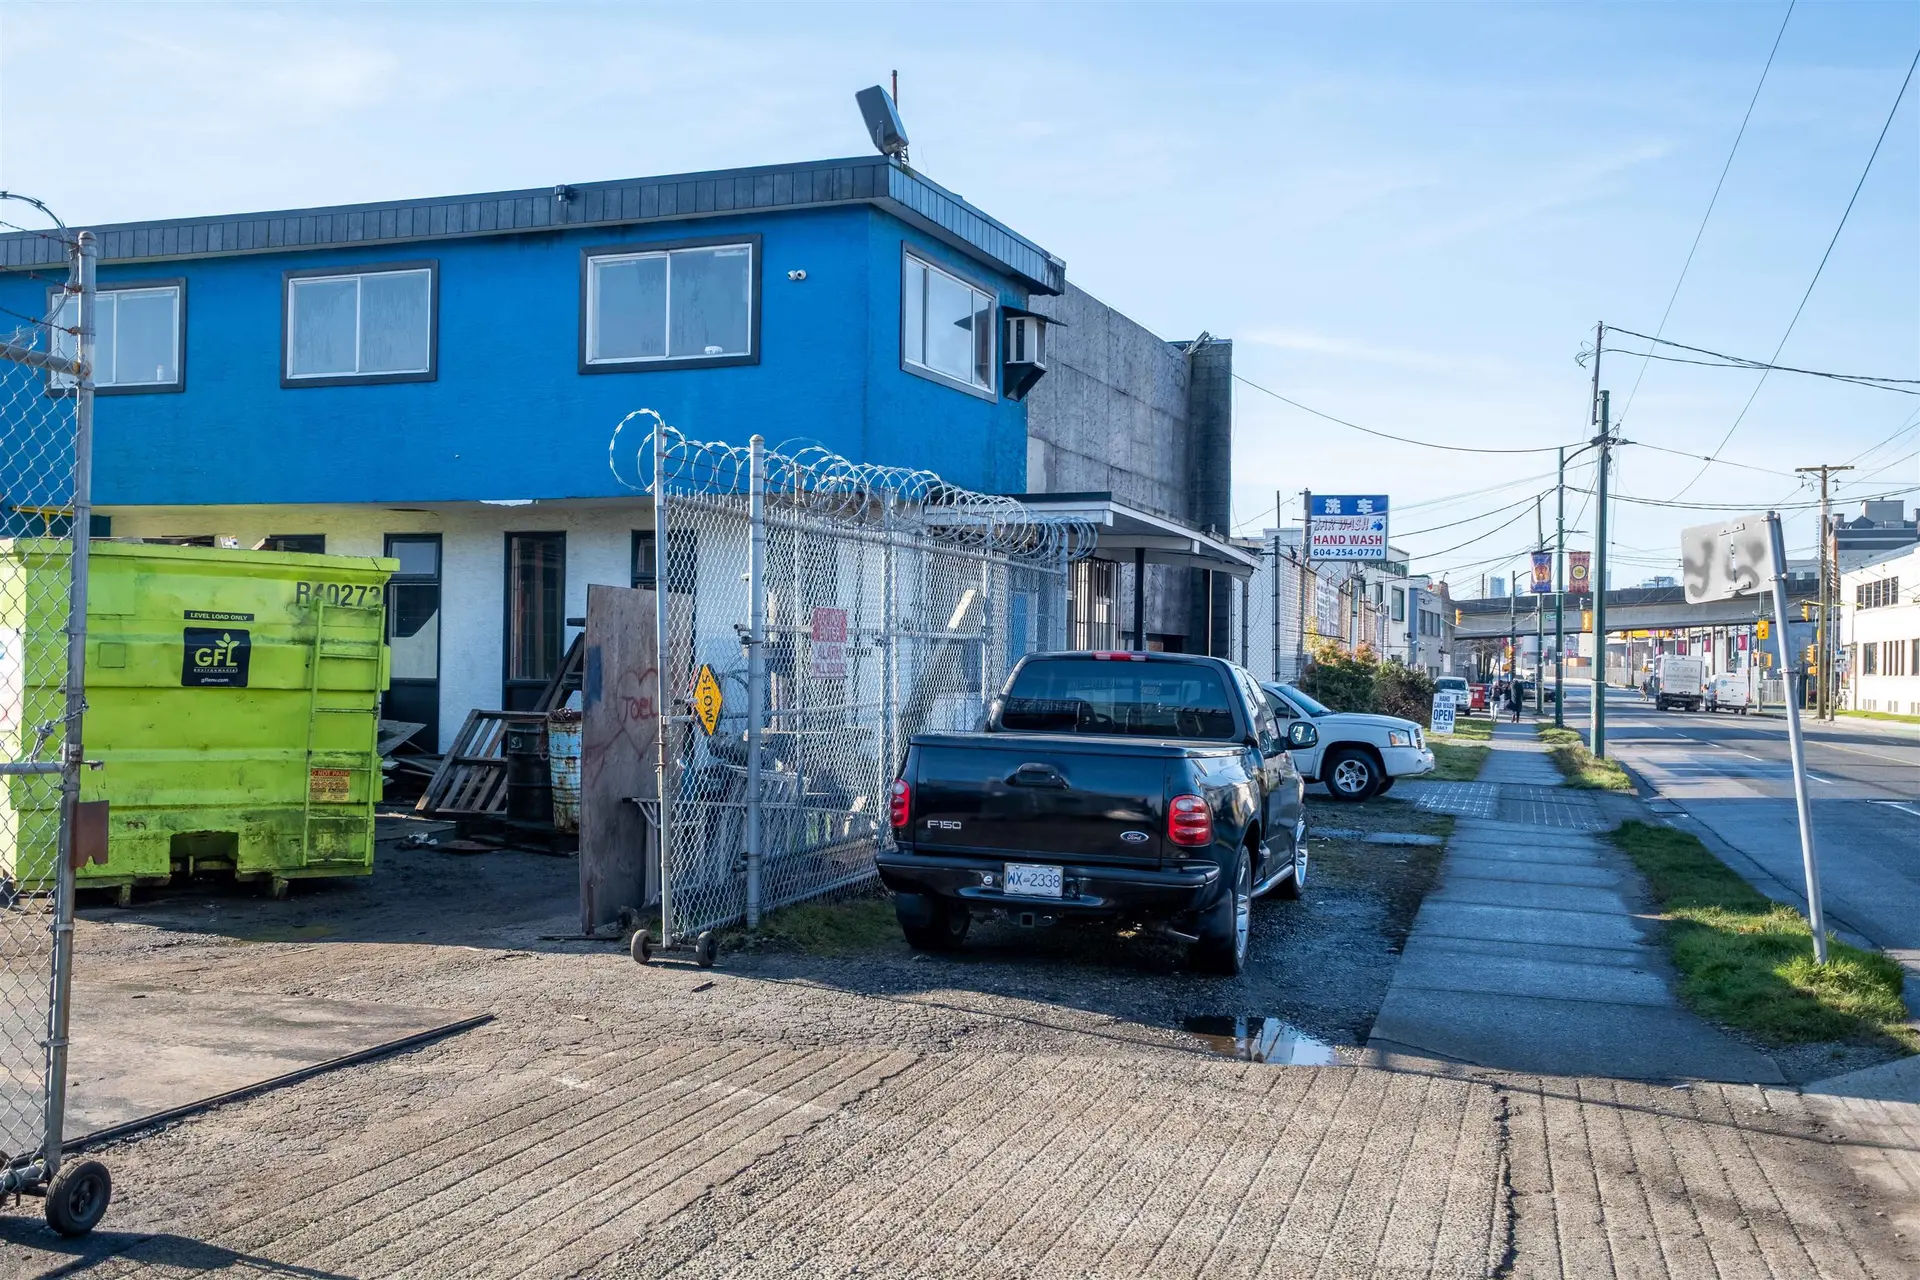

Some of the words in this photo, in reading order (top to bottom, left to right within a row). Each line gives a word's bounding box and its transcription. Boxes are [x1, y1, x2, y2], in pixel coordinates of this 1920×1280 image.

[1313, 535, 1346, 545] HAND
[1349, 535, 1383, 545] WASH
[1313, 548, 1382, 556] 604-254-0770
[194, 641, 240, 667] GFL
[621, 695, 660, 721] JOEL
[702, 674, 713, 723] SLOW
[1433, 709, 1454, 721] OPEN
